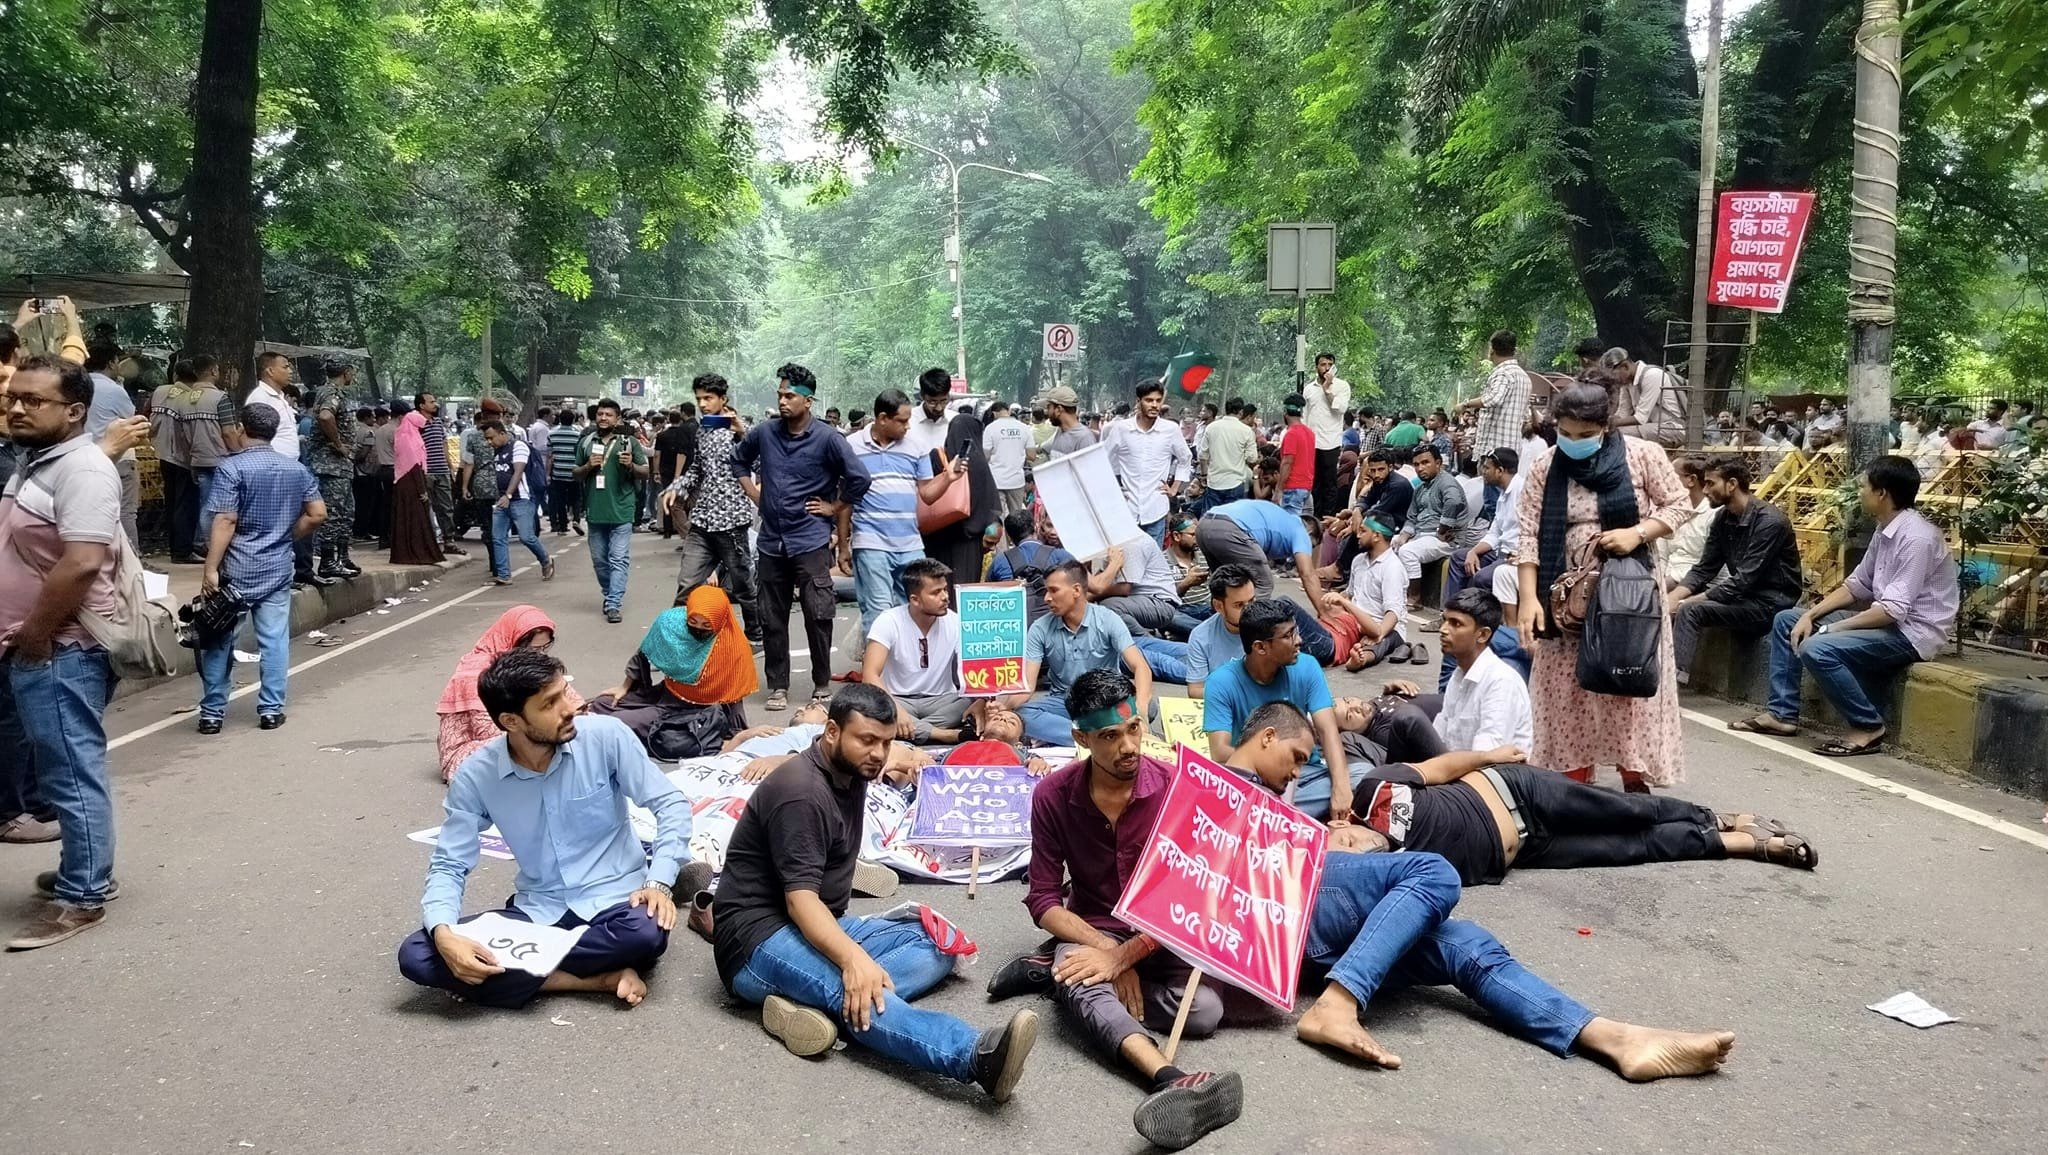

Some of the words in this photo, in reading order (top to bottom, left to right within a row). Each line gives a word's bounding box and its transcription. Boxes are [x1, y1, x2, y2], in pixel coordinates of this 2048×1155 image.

[1731, 192, 1799, 214] বয়সসীমা
[1729, 214, 1760, 240] বৃদ্ধি
[1730, 240, 1786, 256] যোগ্যতা
[1726, 261, 1782, 278] প্রমাণের
[1716, 281, 1759, 301] সুযোগ
[966, 593, 1017, 612] চাকরিতে
[961, 619, 1021, 635] আবেদনের
[966, 636, 1018, 656] বয়সসীমা
[965, 668, 989, 688] ৩৫
[993, 659, 1021, 687] চাই
[945, 768, 1005, 780] We
[931, 782, 1031, 794] Want
[1186, 761, 1247, 816] যোগ্যতা
[954, 795, 1008, 807] No
[939, 808, 1020, 823] Age
[1192, 805, 1242, 858] সুযোগ
[1157, 832, 1230, 900] বয়সসীমা
[1169, 902, 1201, 935] ৩৫
[487, 937, 541, 961] ৩৫
